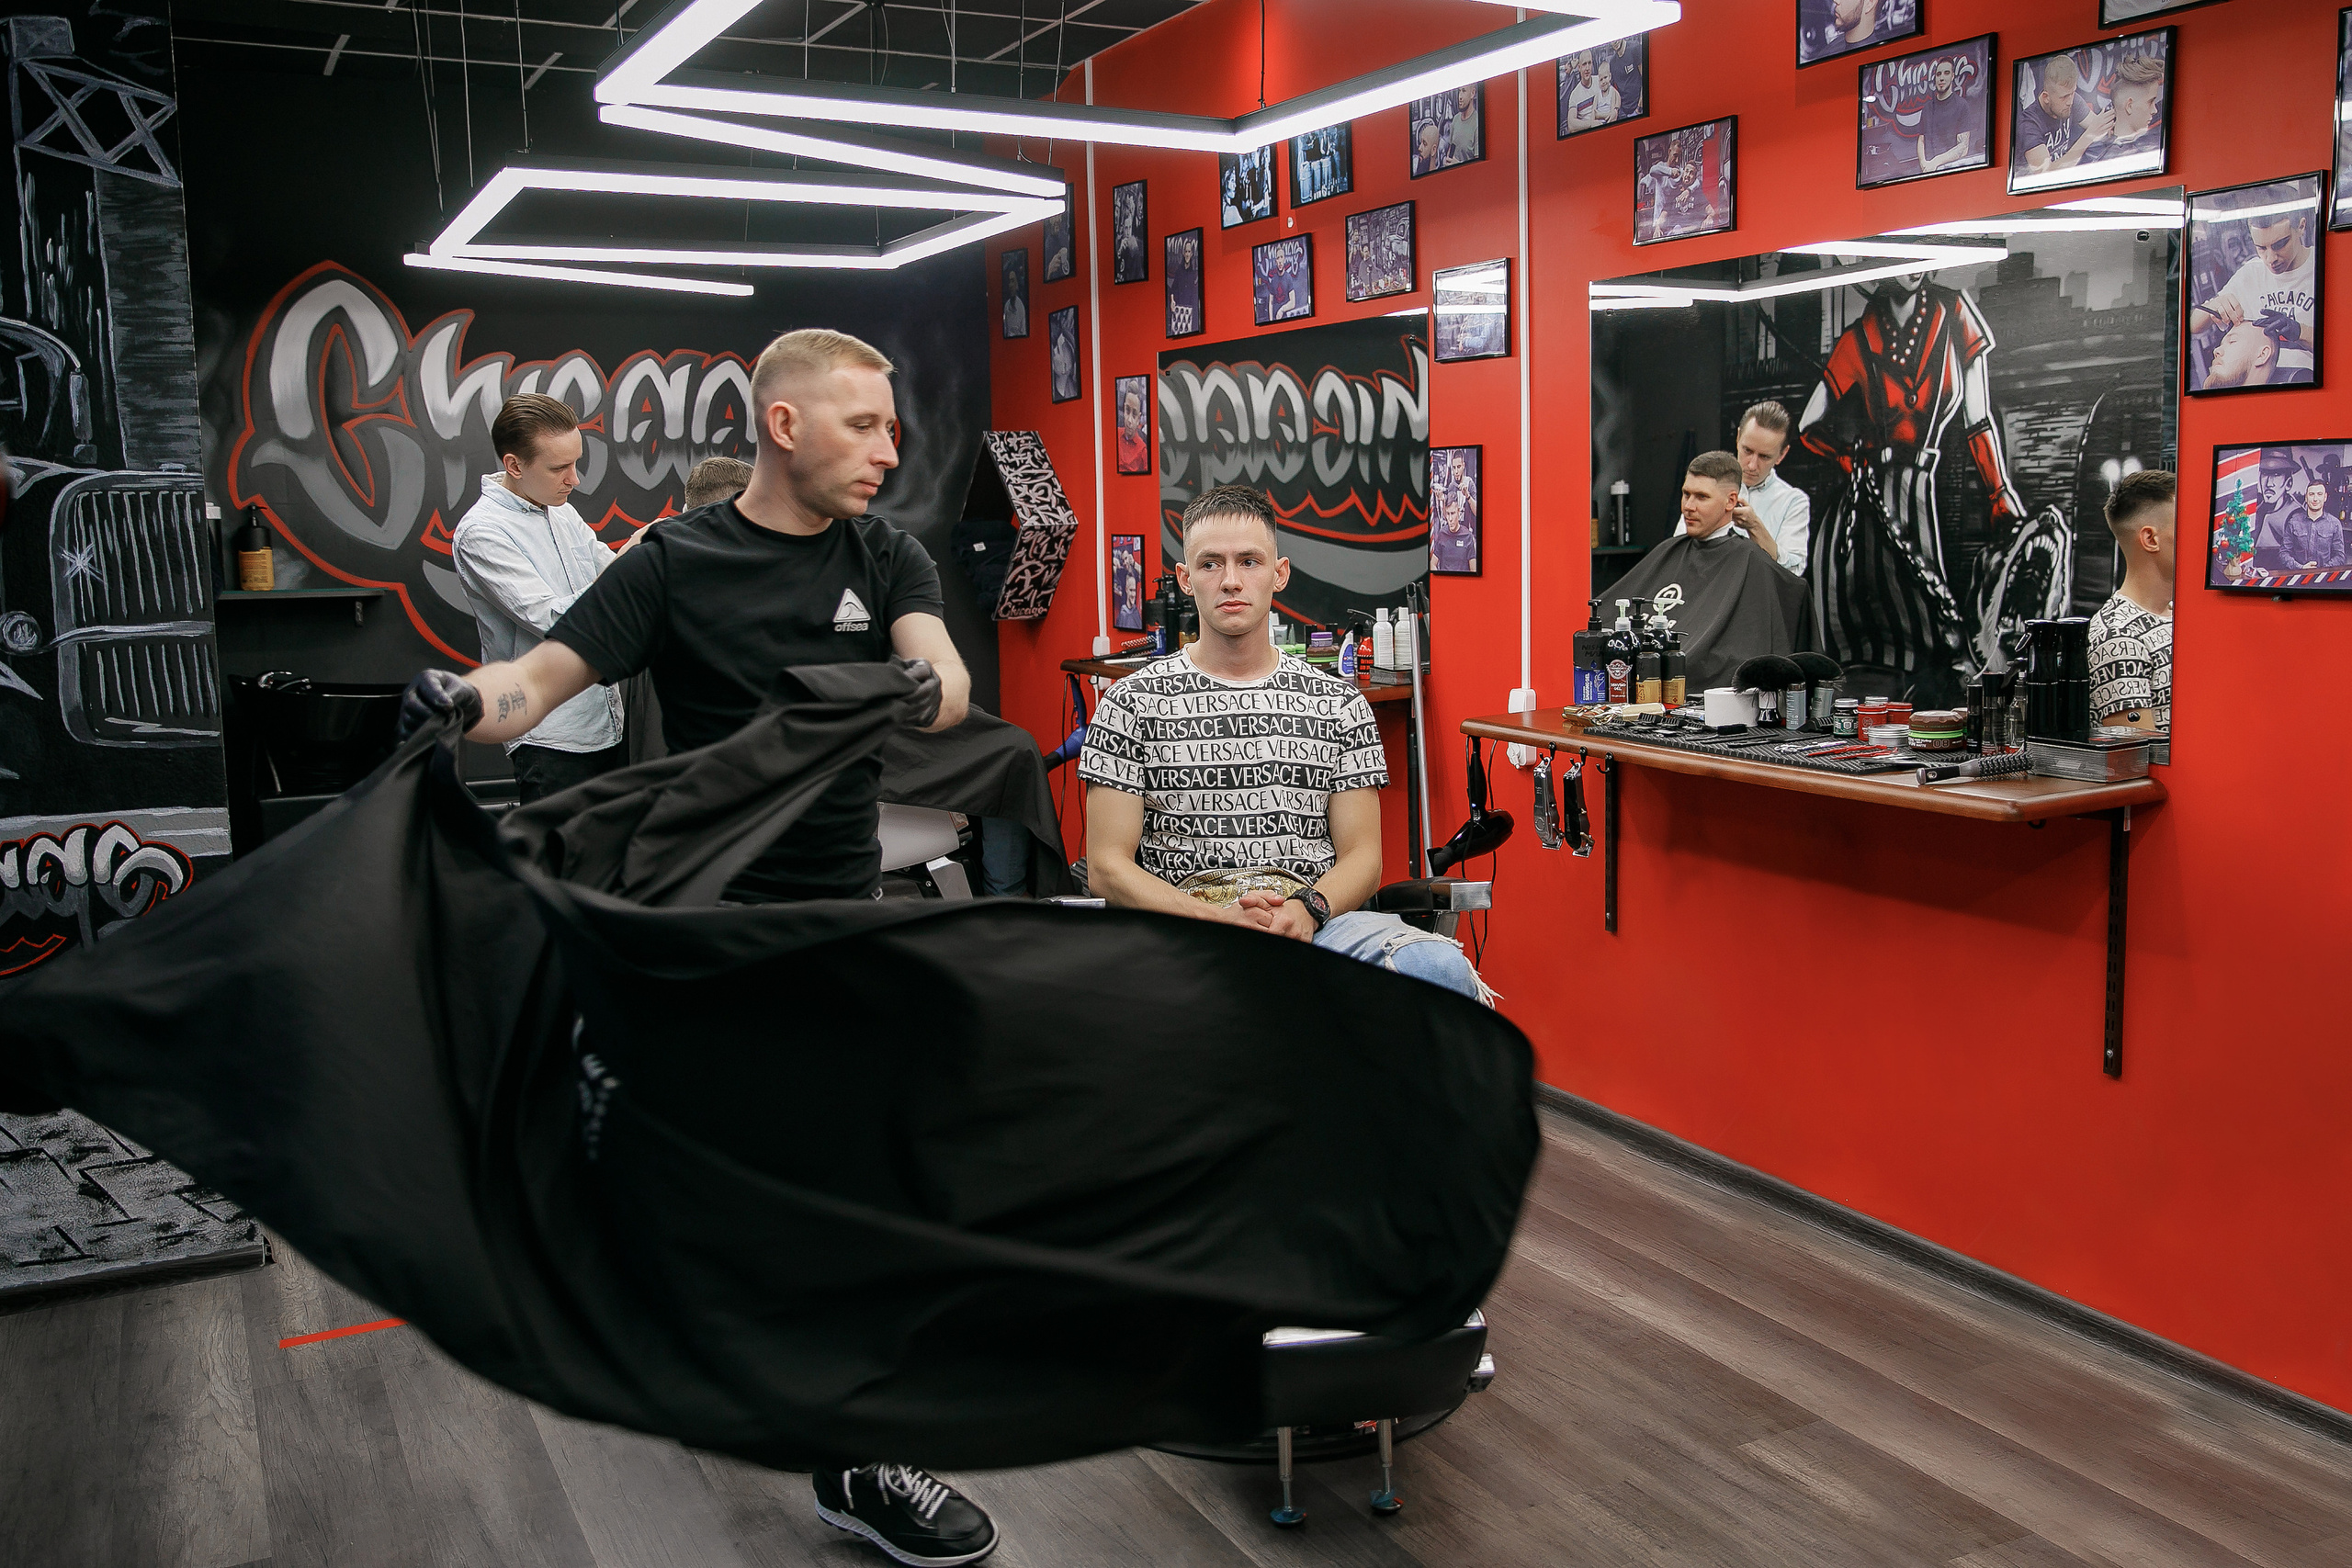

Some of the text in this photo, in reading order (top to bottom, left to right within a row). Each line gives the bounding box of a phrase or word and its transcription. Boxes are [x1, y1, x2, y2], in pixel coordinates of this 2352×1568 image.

[833, 622, 869, 632] offsea
[1182, 693, 1261, 716] VERSACE
[1264, 693, 1338, 716] VERSACE
[1146, 717, 1225, 739] VERSACE
[1227, 715, 1302, 737] VERSACE
[1186, 740, 1263, 762] VERSACE
[1267, 739, 1339, 764] VERSACE
[1148, 766, 1227, 789] VERSACE
[1229, 763, 1302, 787] VERSACE
[1189, 791, 1269, 811] VERSACE
[1153, 813, 1228, 836] VERSACE
[1157, 850, 1228, 871] VERSACE
[1192, 838, 1272, 860] VERSACE
